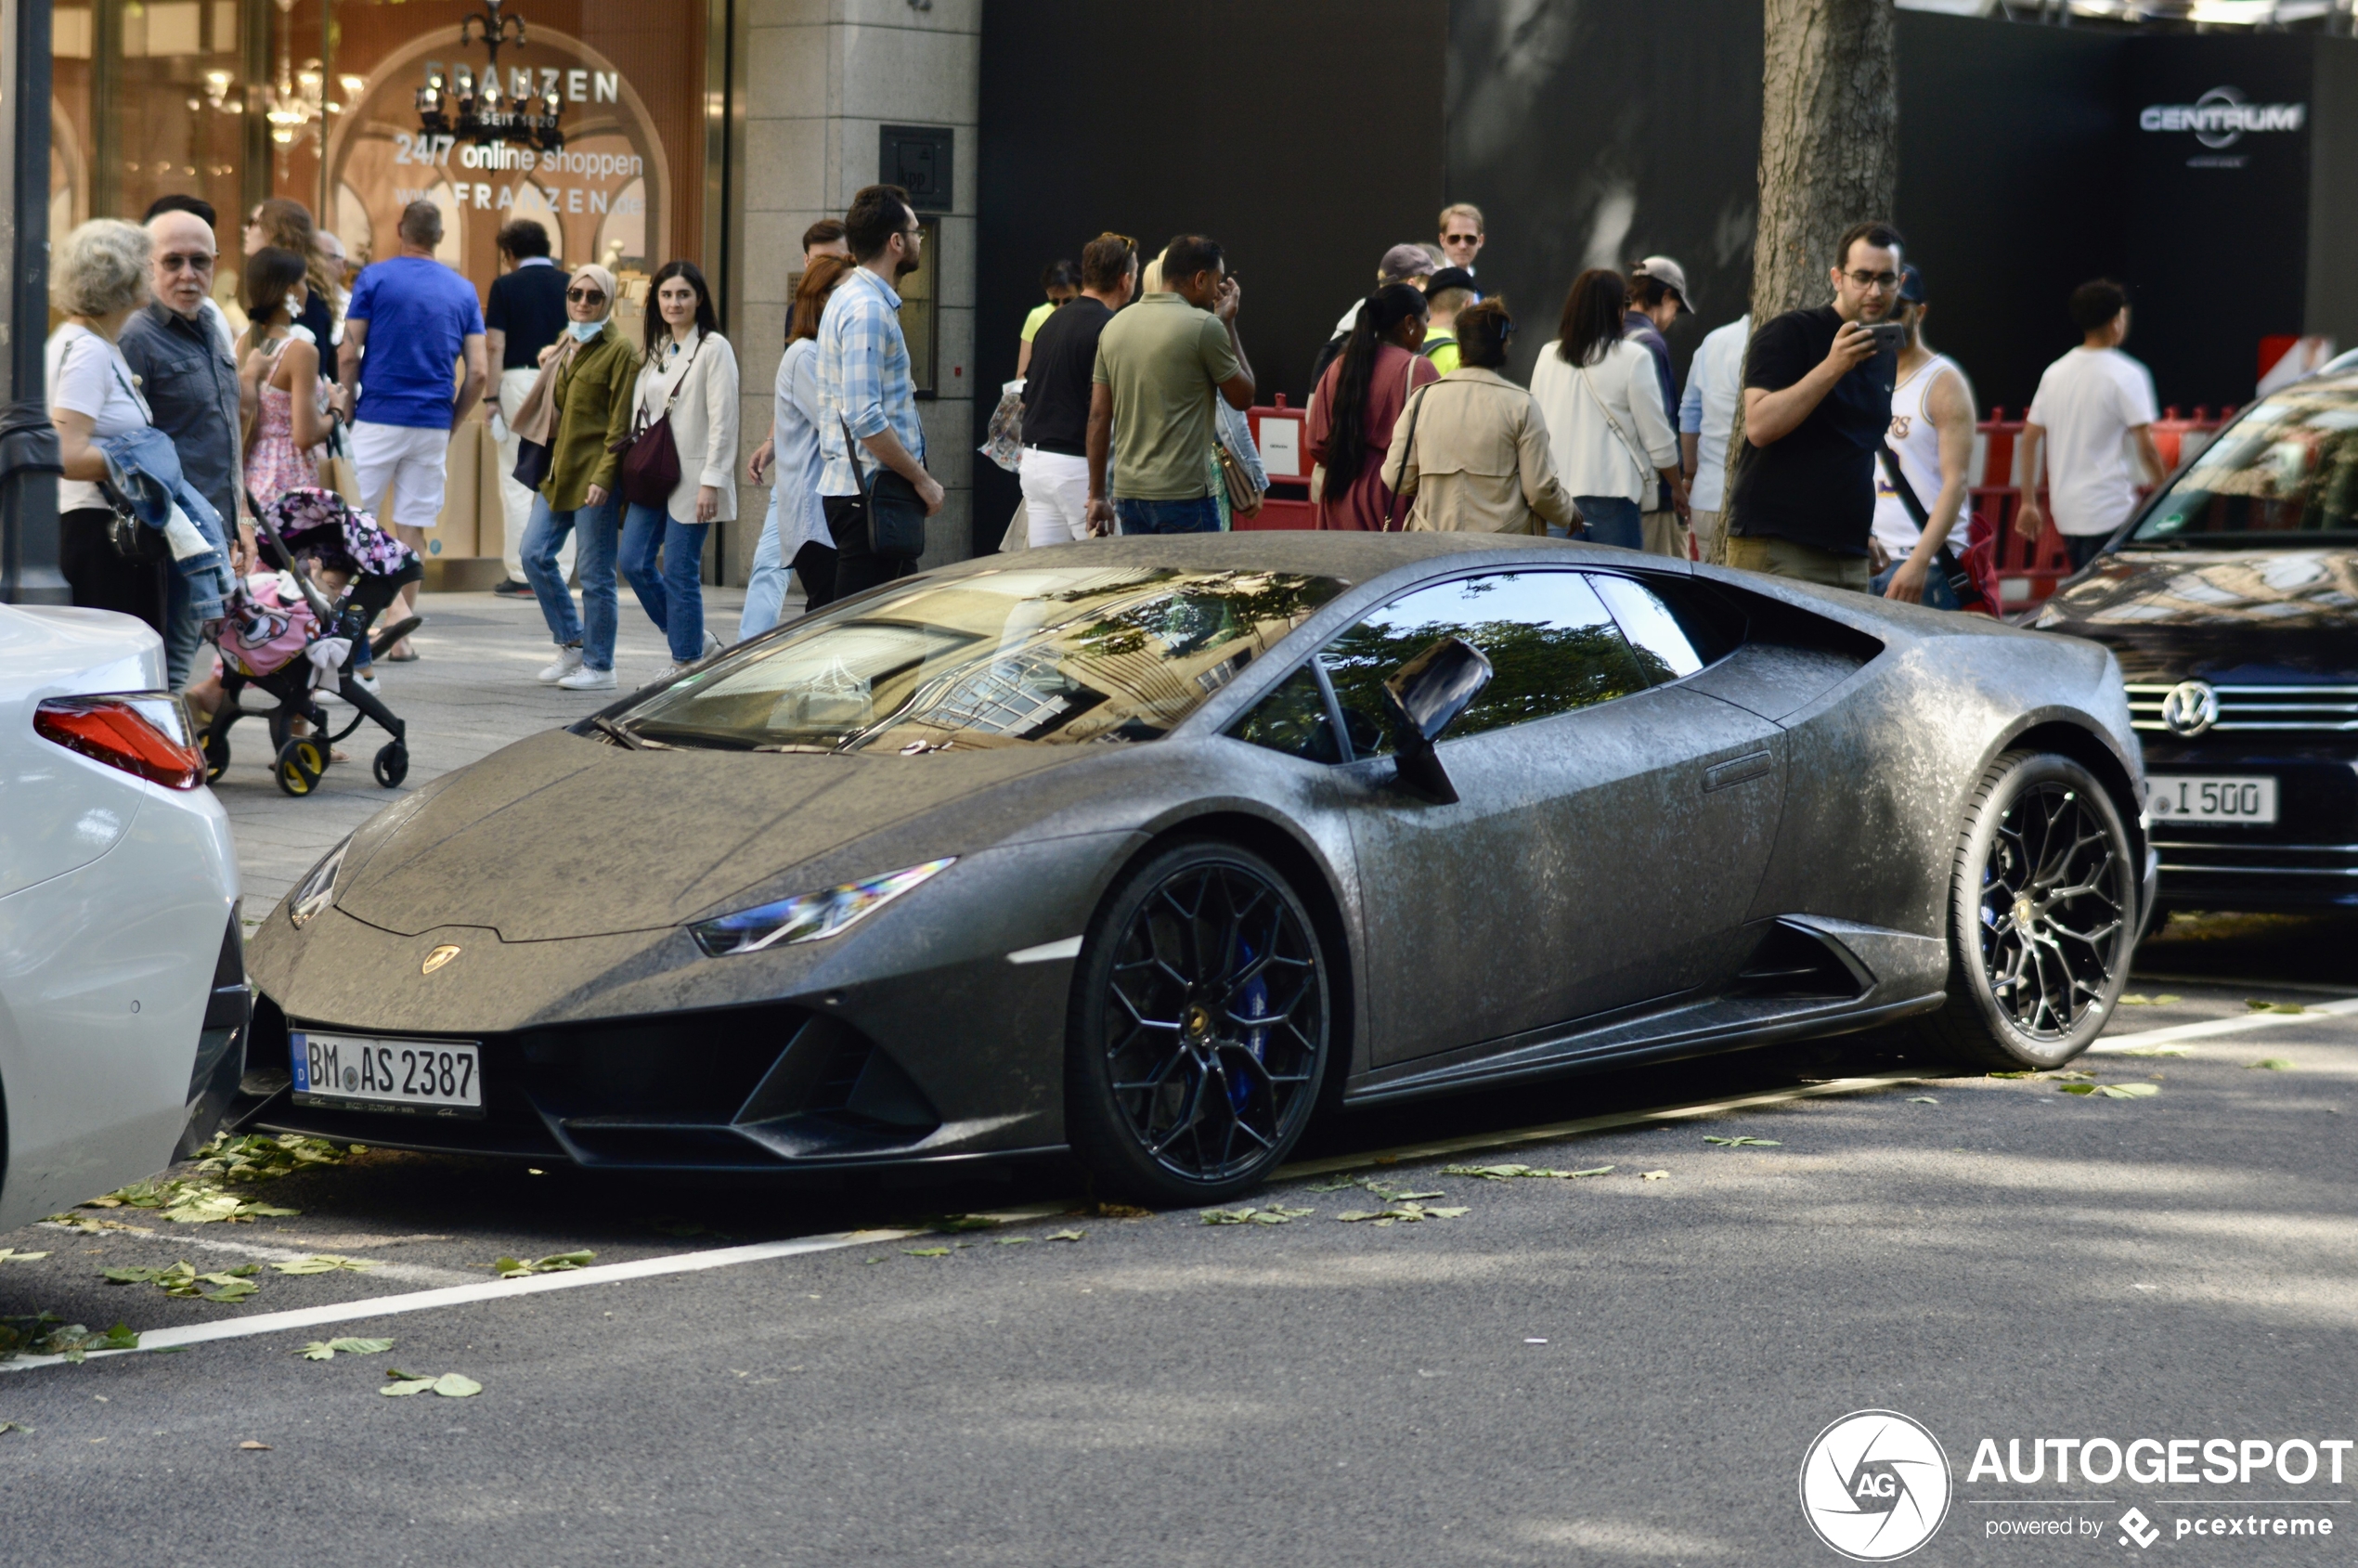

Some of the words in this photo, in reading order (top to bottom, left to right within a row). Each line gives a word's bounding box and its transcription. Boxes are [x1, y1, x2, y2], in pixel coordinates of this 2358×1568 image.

[425, 61, 618, 104] FRANZEN
[481, 112, 515, 127] SEIT
[520, 114, 556, 130] 1820
[2140, 105, 2304, 132] CENTRUM
[394, 134, 456, 166] 24/7
[460, 140, 536, 171] online
[542, 146, 643, 180] shoppen
[2200, 783, 2259, 815] 500
[298, 1068, 305, 1082] D
[308, 1042, 339, 1088] BM
[361, 1046, 394, 1092] AS
[401, 1049, 473, 1098] 2387
